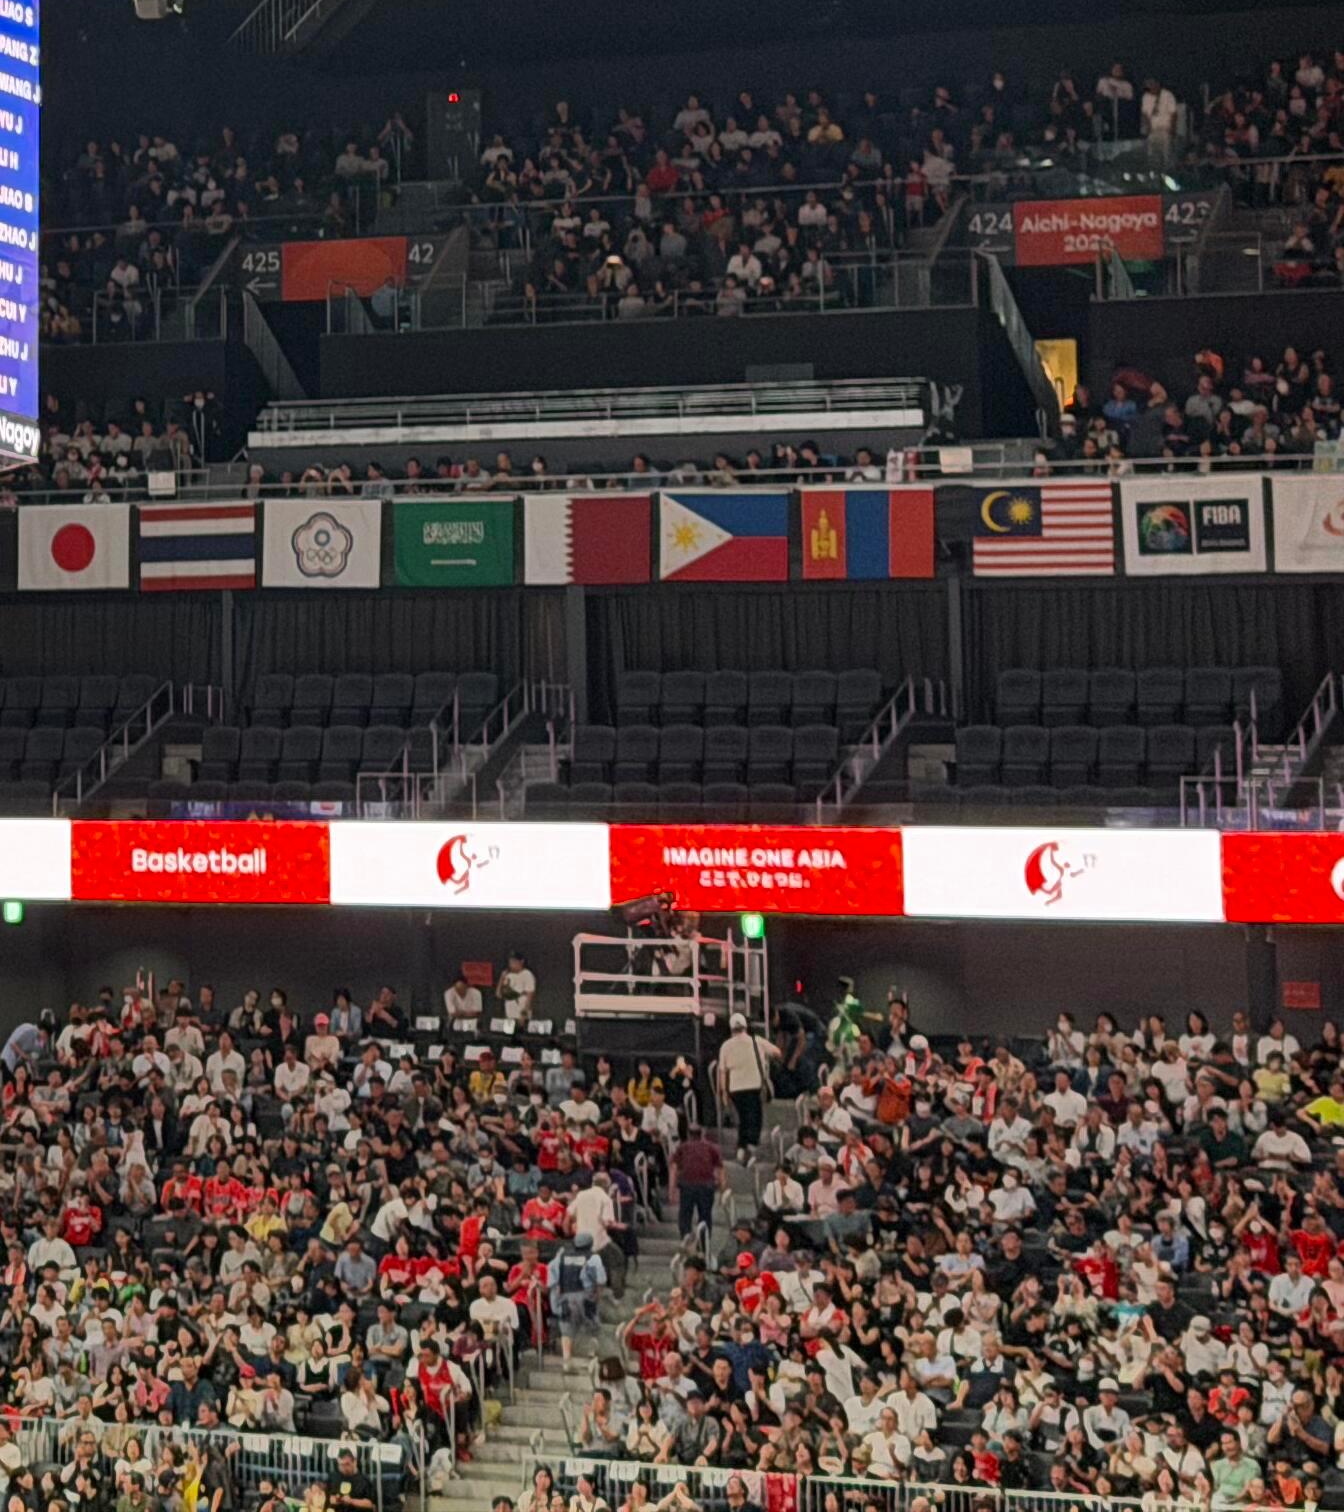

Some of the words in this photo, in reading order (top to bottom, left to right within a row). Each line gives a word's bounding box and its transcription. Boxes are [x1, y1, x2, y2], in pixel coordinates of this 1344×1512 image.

[968, 212, 1012, 235] 424
[1020, 213, 1157, 234] Aichi-Nagoya
[242, 252, 280, 272] 425
[1202, 505, 1241, 525] FIBA
[131, 848, 266, 874] Basketball
[663, 846, 748, 867] IMAGINE
[751, 848, 794, 868] ONE
[798, 849, 847, 869] ASIA
